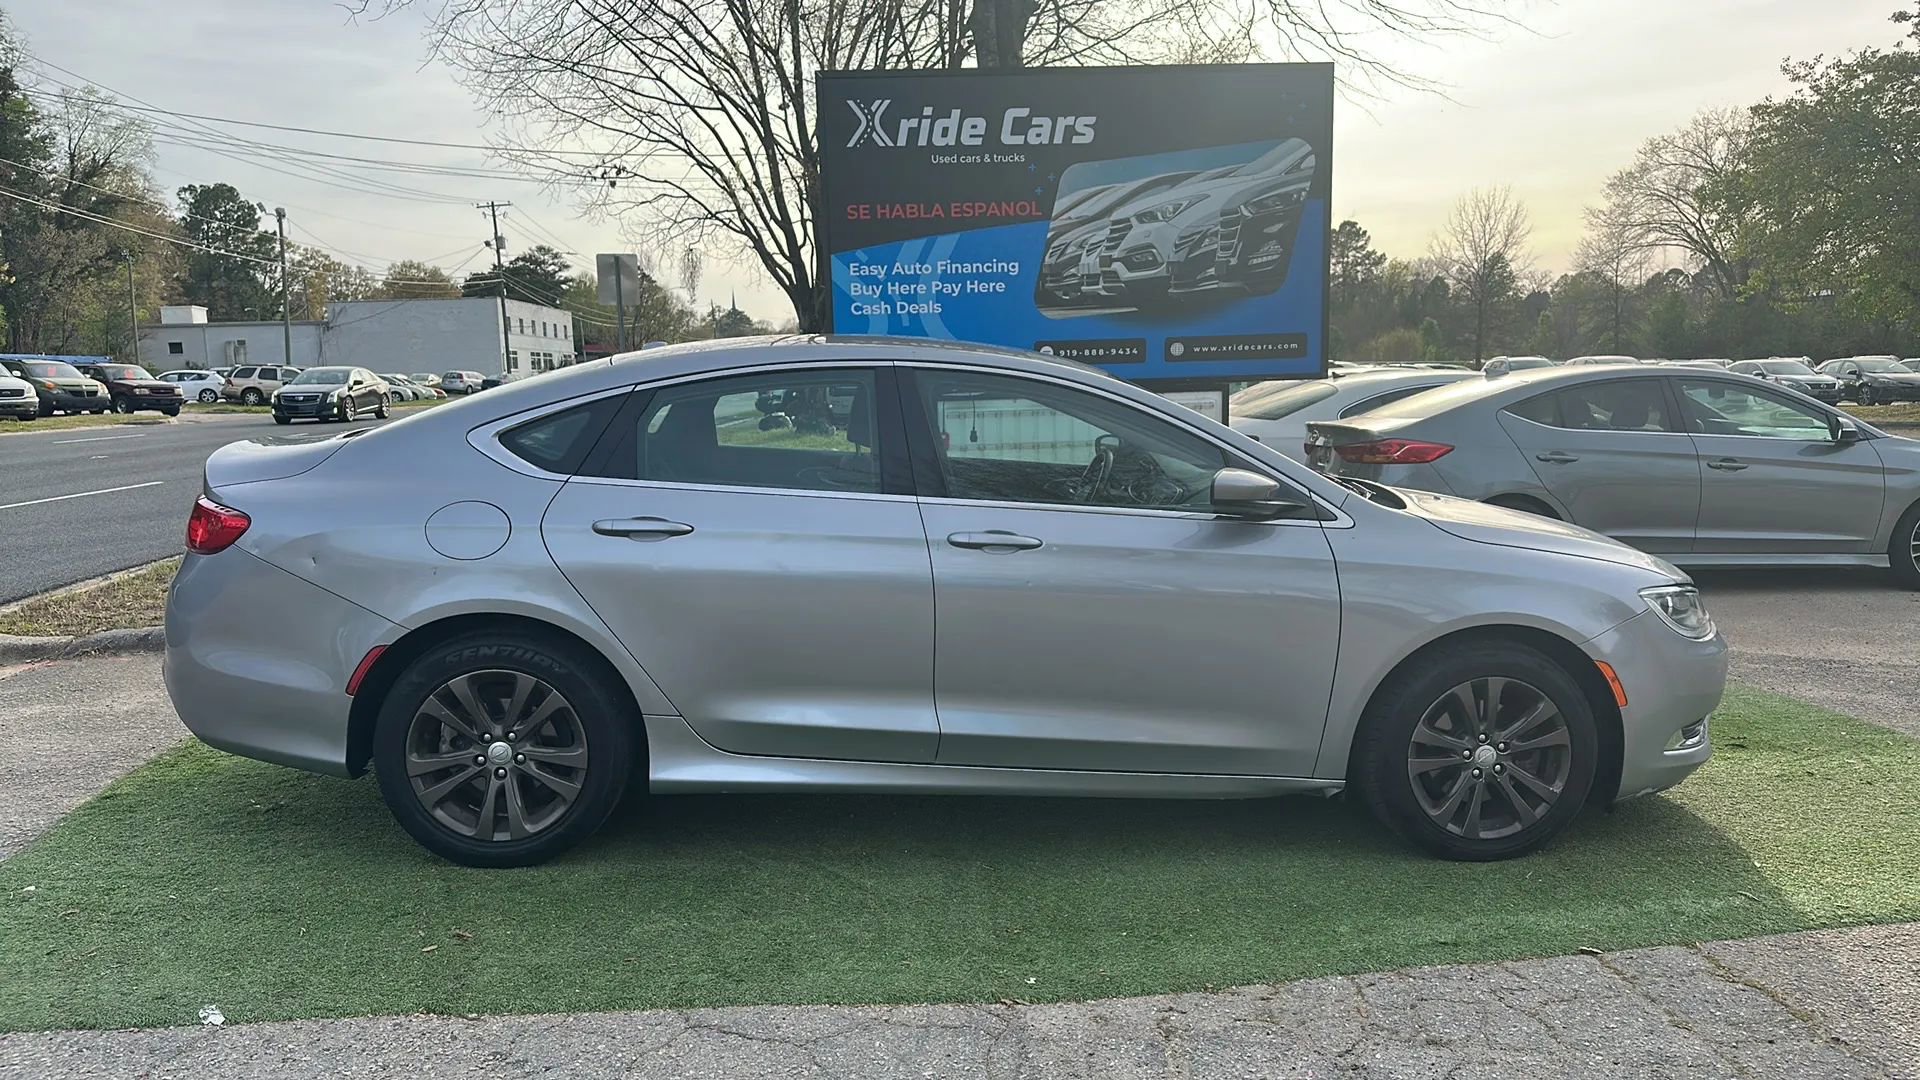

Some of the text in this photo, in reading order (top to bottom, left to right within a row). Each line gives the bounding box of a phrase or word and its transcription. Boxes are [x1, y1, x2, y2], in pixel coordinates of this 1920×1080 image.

[1000, 107, 1097, 145] Cars
[931, 152, 1025, 164] Used cars & trucks
[847, 200, 1042, 220] SE HABLA ESPANOL
[850, 259, 1020, 278] Easy Auto Financing
[850, 280, 1006, 298] Buy Here Pay Here
[851, 301, 942, 315] Cash Deals
[1059, 347, 1139, 358] 919-888-9434
[1193, 341, 1299, 353] www.xridecars.com
